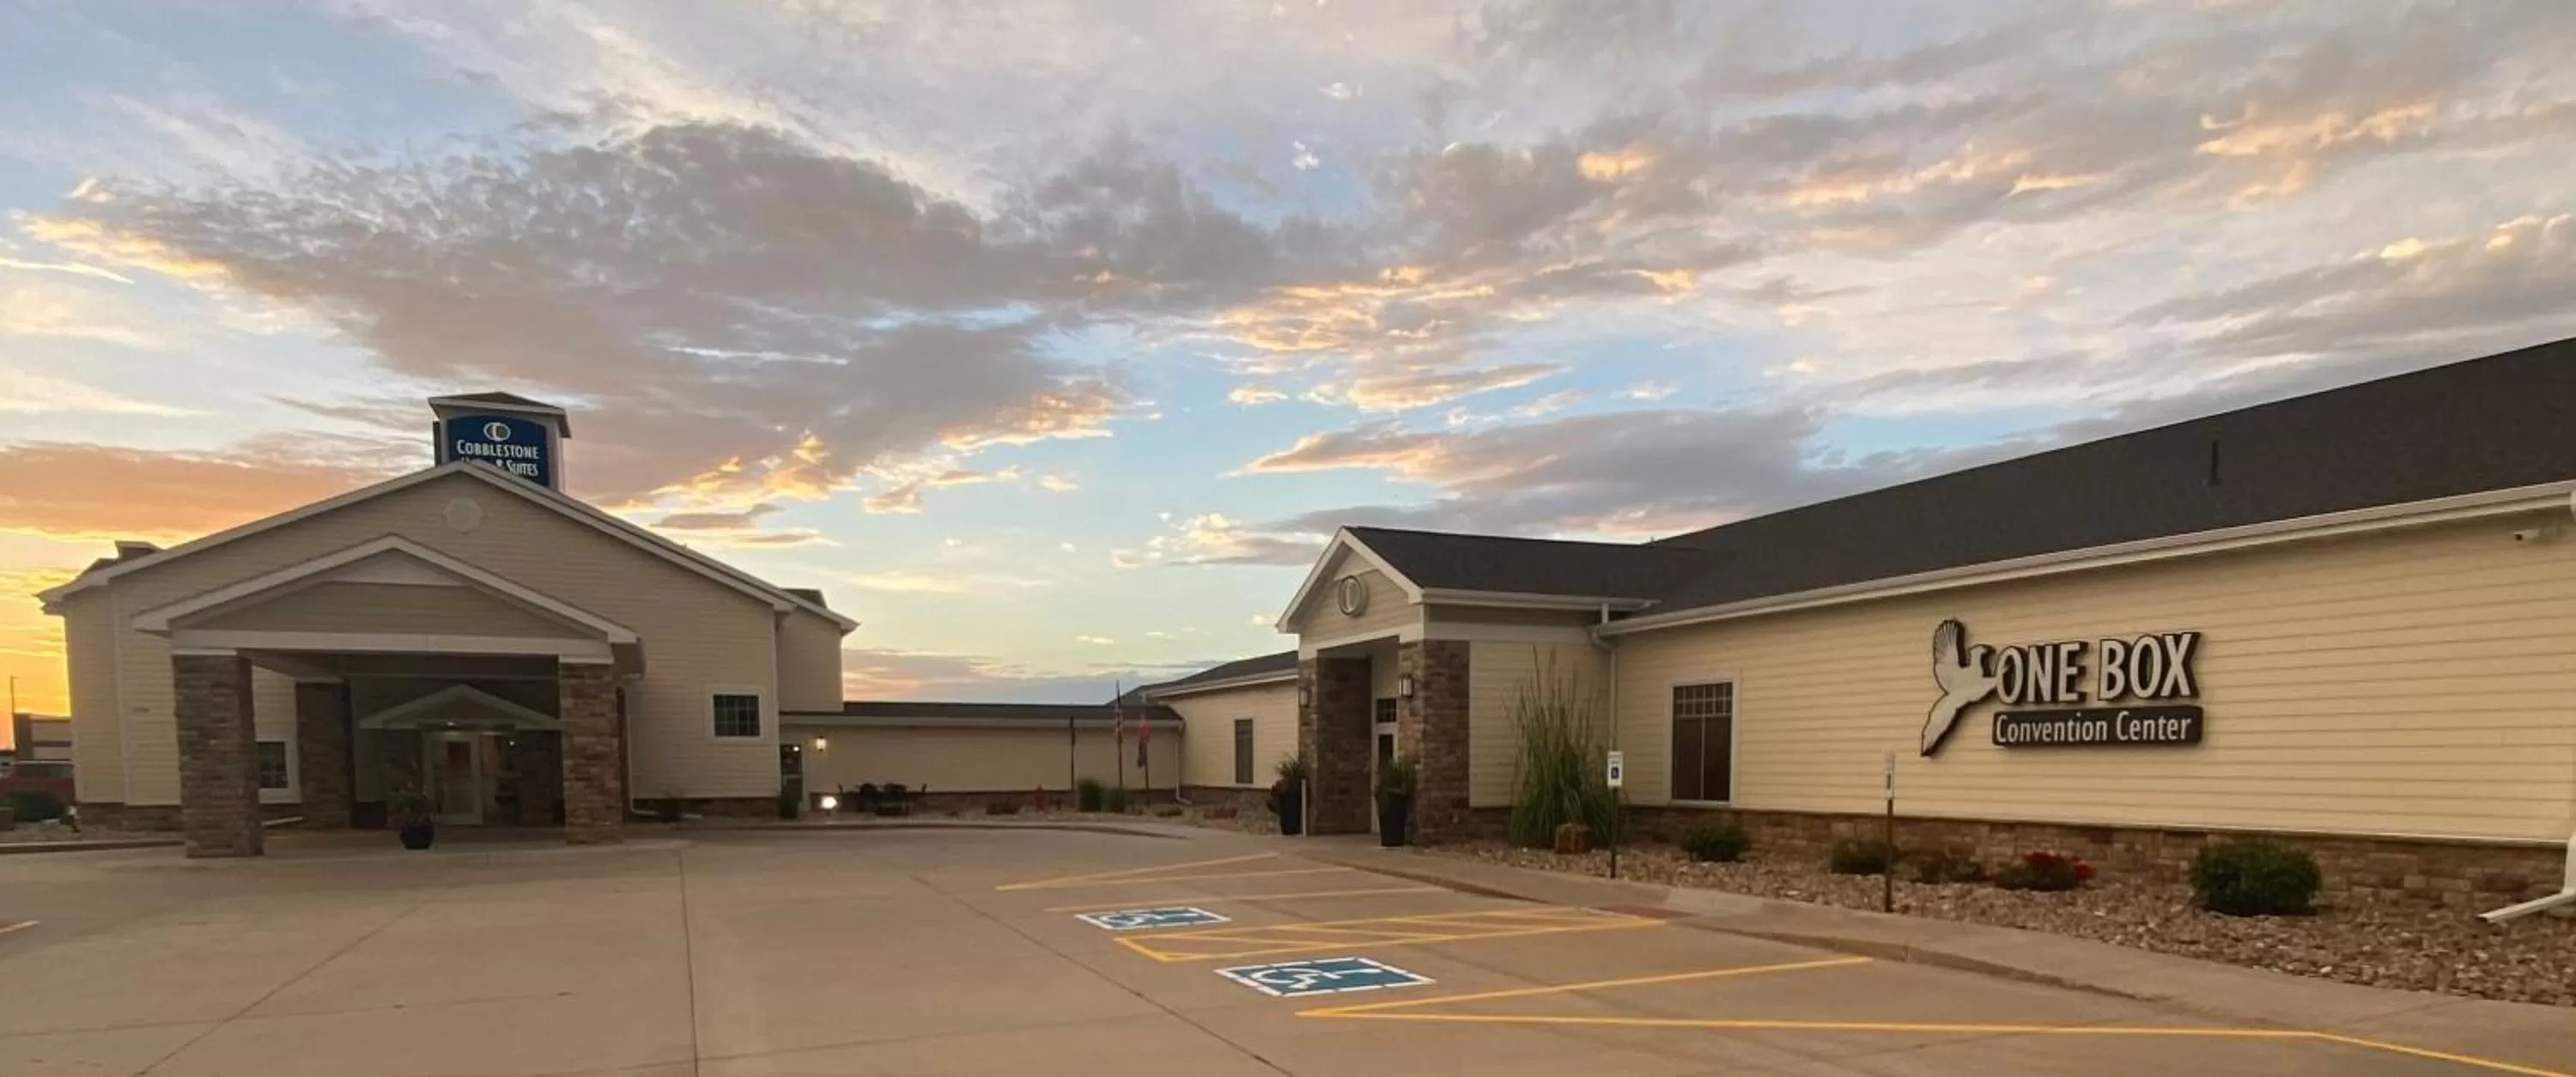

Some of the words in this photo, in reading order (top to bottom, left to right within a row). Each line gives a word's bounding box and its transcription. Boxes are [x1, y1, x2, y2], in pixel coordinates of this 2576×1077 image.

[456, 439, 540, 459] COBBLESTONE
[1996, 642, 2086, 704] ONE
[2099, 632, 2197, 701] BOX
[1996, 712, 2108, 743] Convention
[2116, 710, 2192, 741] Center
